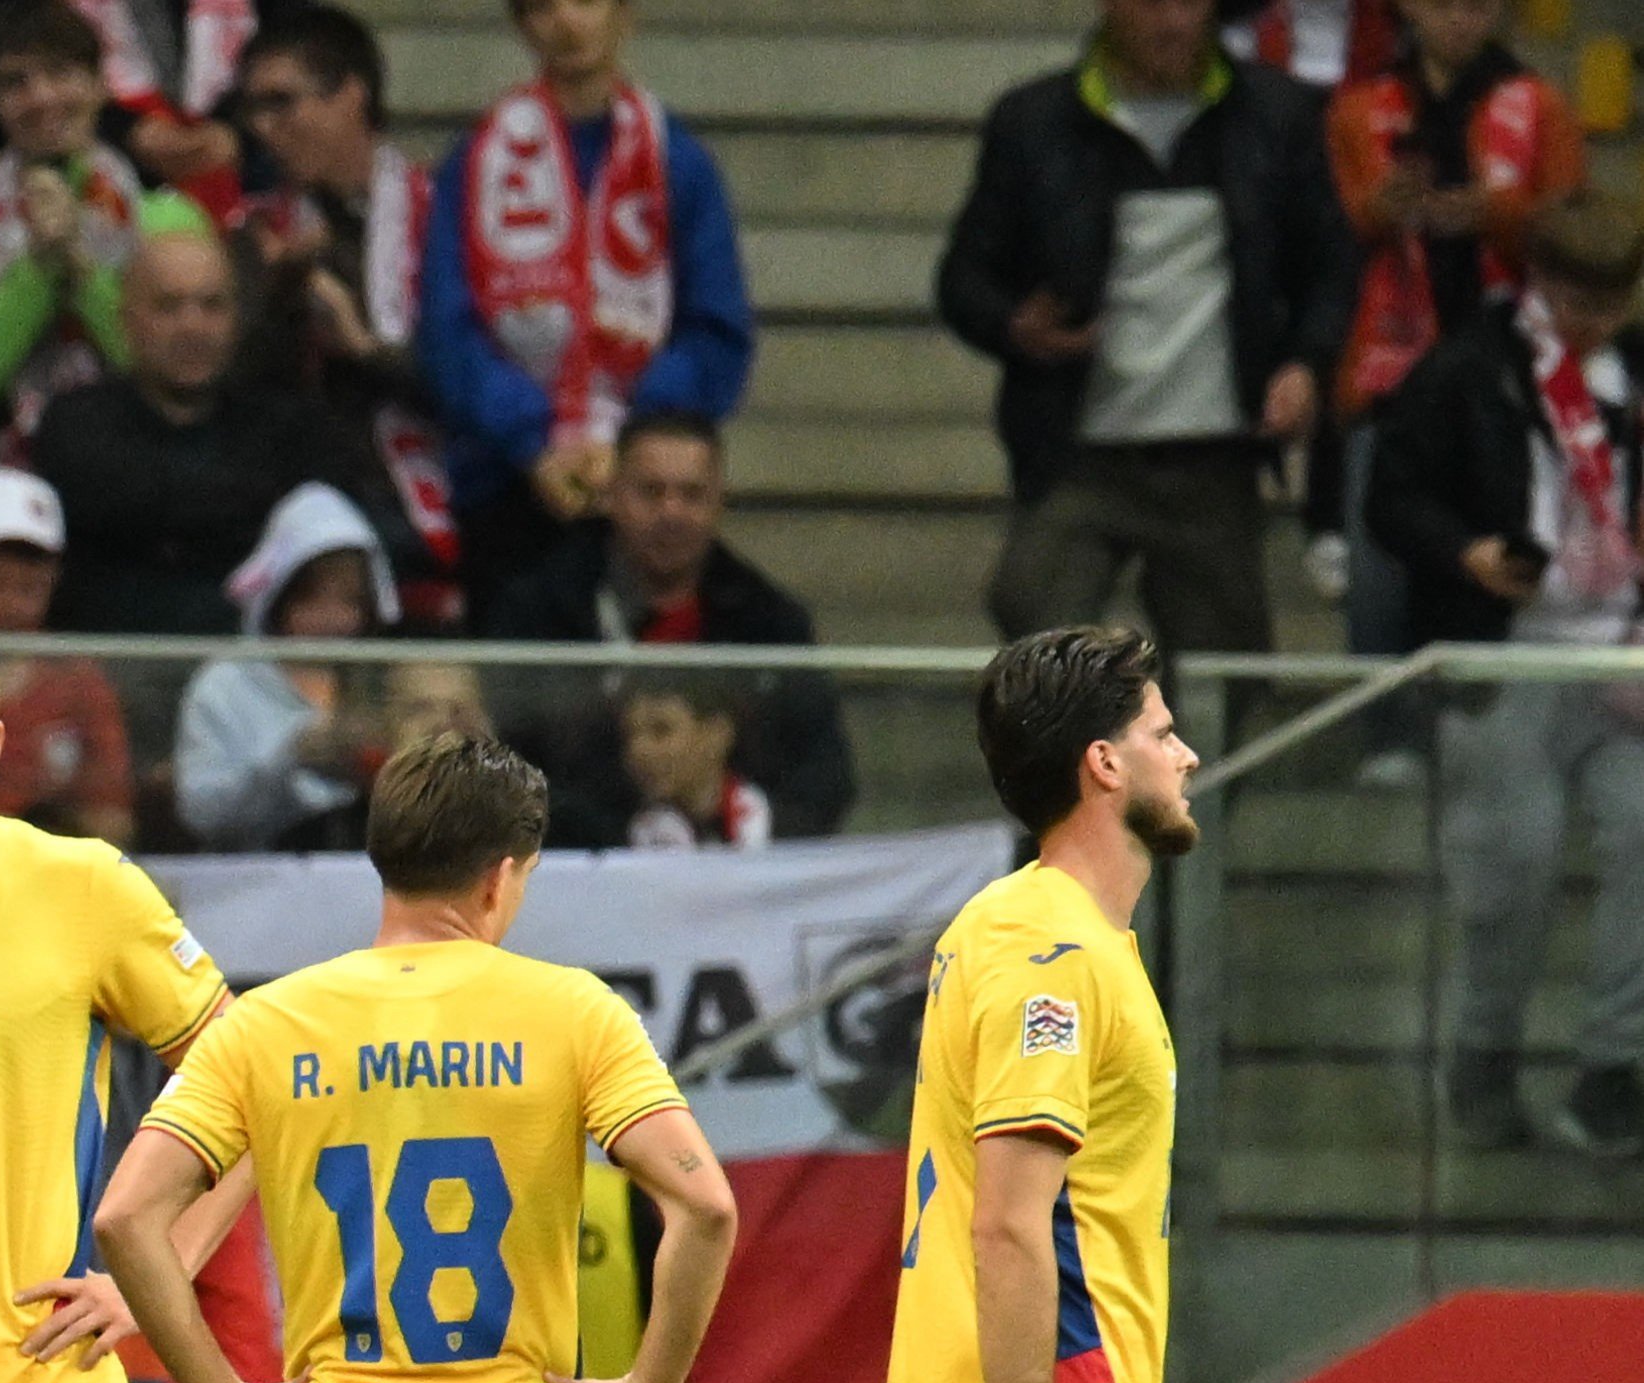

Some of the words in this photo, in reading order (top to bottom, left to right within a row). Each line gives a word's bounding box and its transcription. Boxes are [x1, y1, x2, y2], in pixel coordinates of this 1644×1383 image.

[293, 1052, 335, 1099] R.
[358, 1040, 523, 1092] MARIN
[314, 1136, 515, 1365] 18
